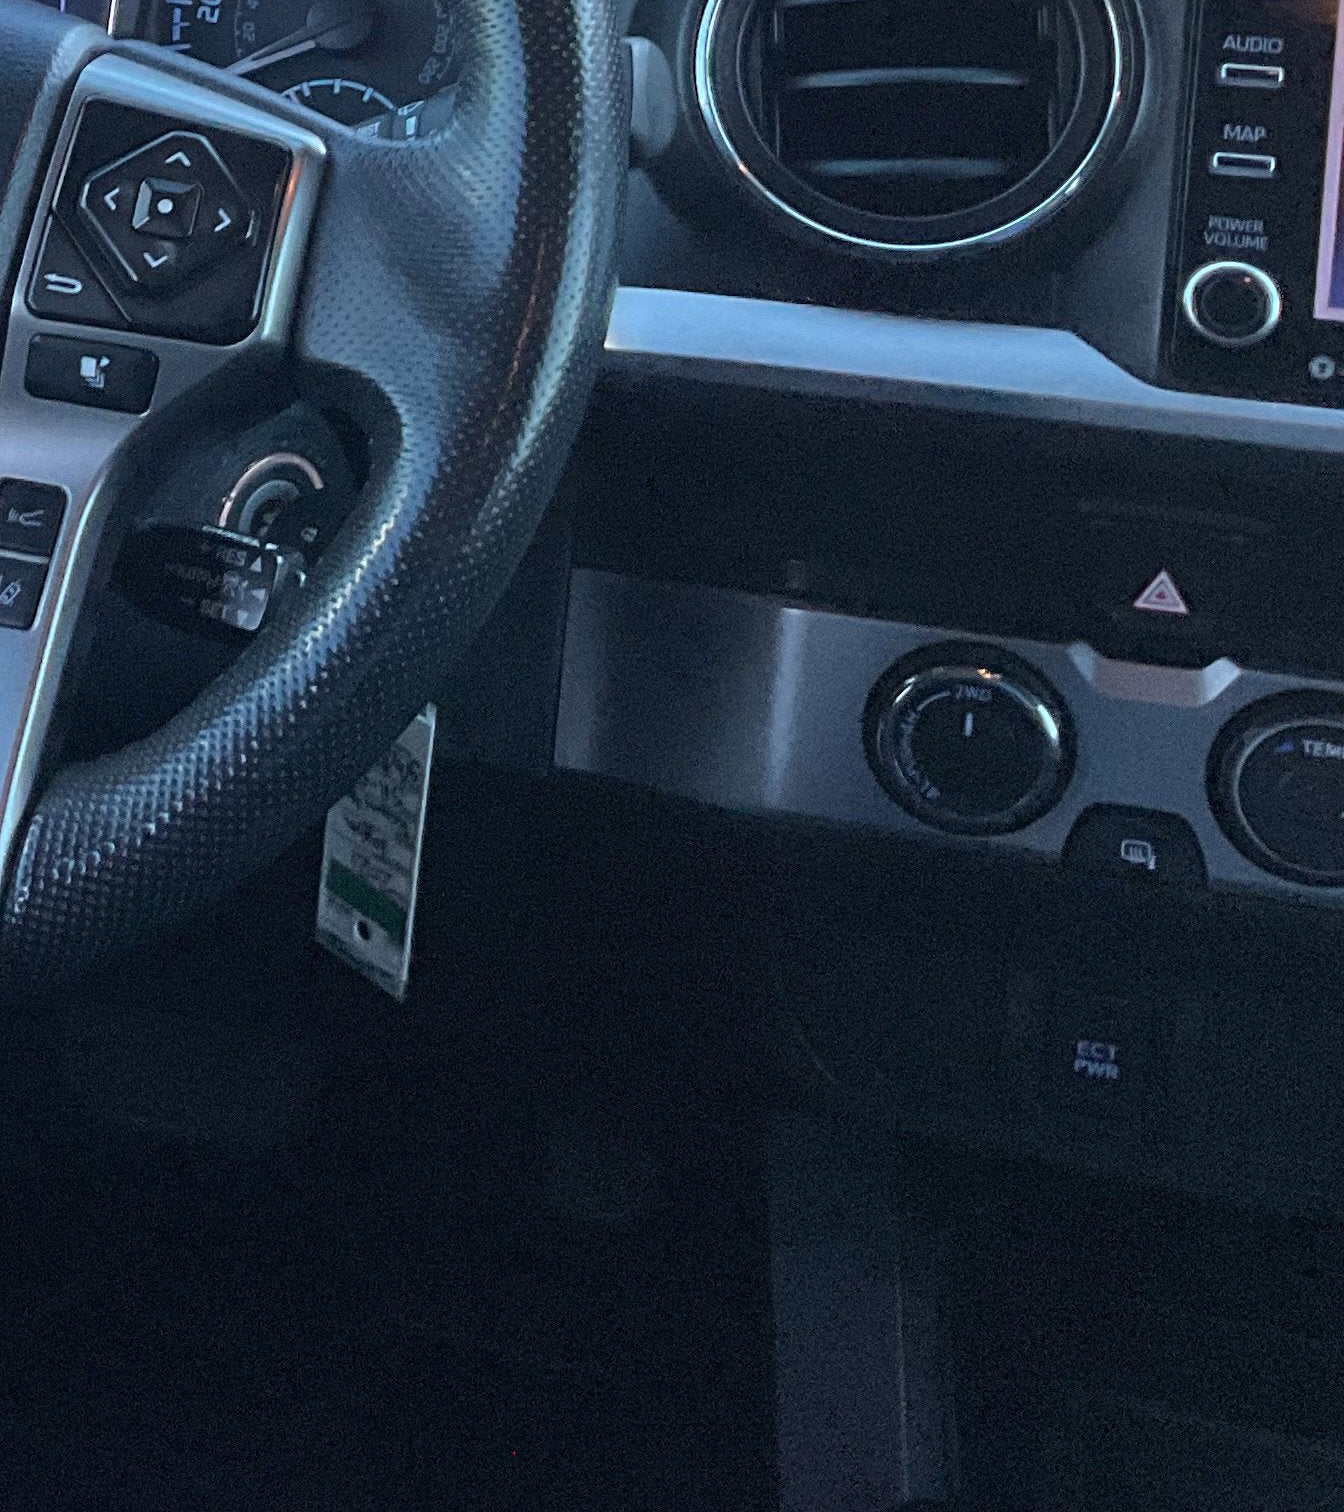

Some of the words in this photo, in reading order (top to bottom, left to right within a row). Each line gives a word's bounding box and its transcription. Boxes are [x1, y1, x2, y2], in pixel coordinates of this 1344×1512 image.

[1222, 34, 1284, 54] AUDIO
[1223, 123, 1266, 142] MAP
[1208, 214, 1263, 233] POWER
[1203, 230, 1269, 251] VOLUME
[1302, 738, 1344, 760] TEM
